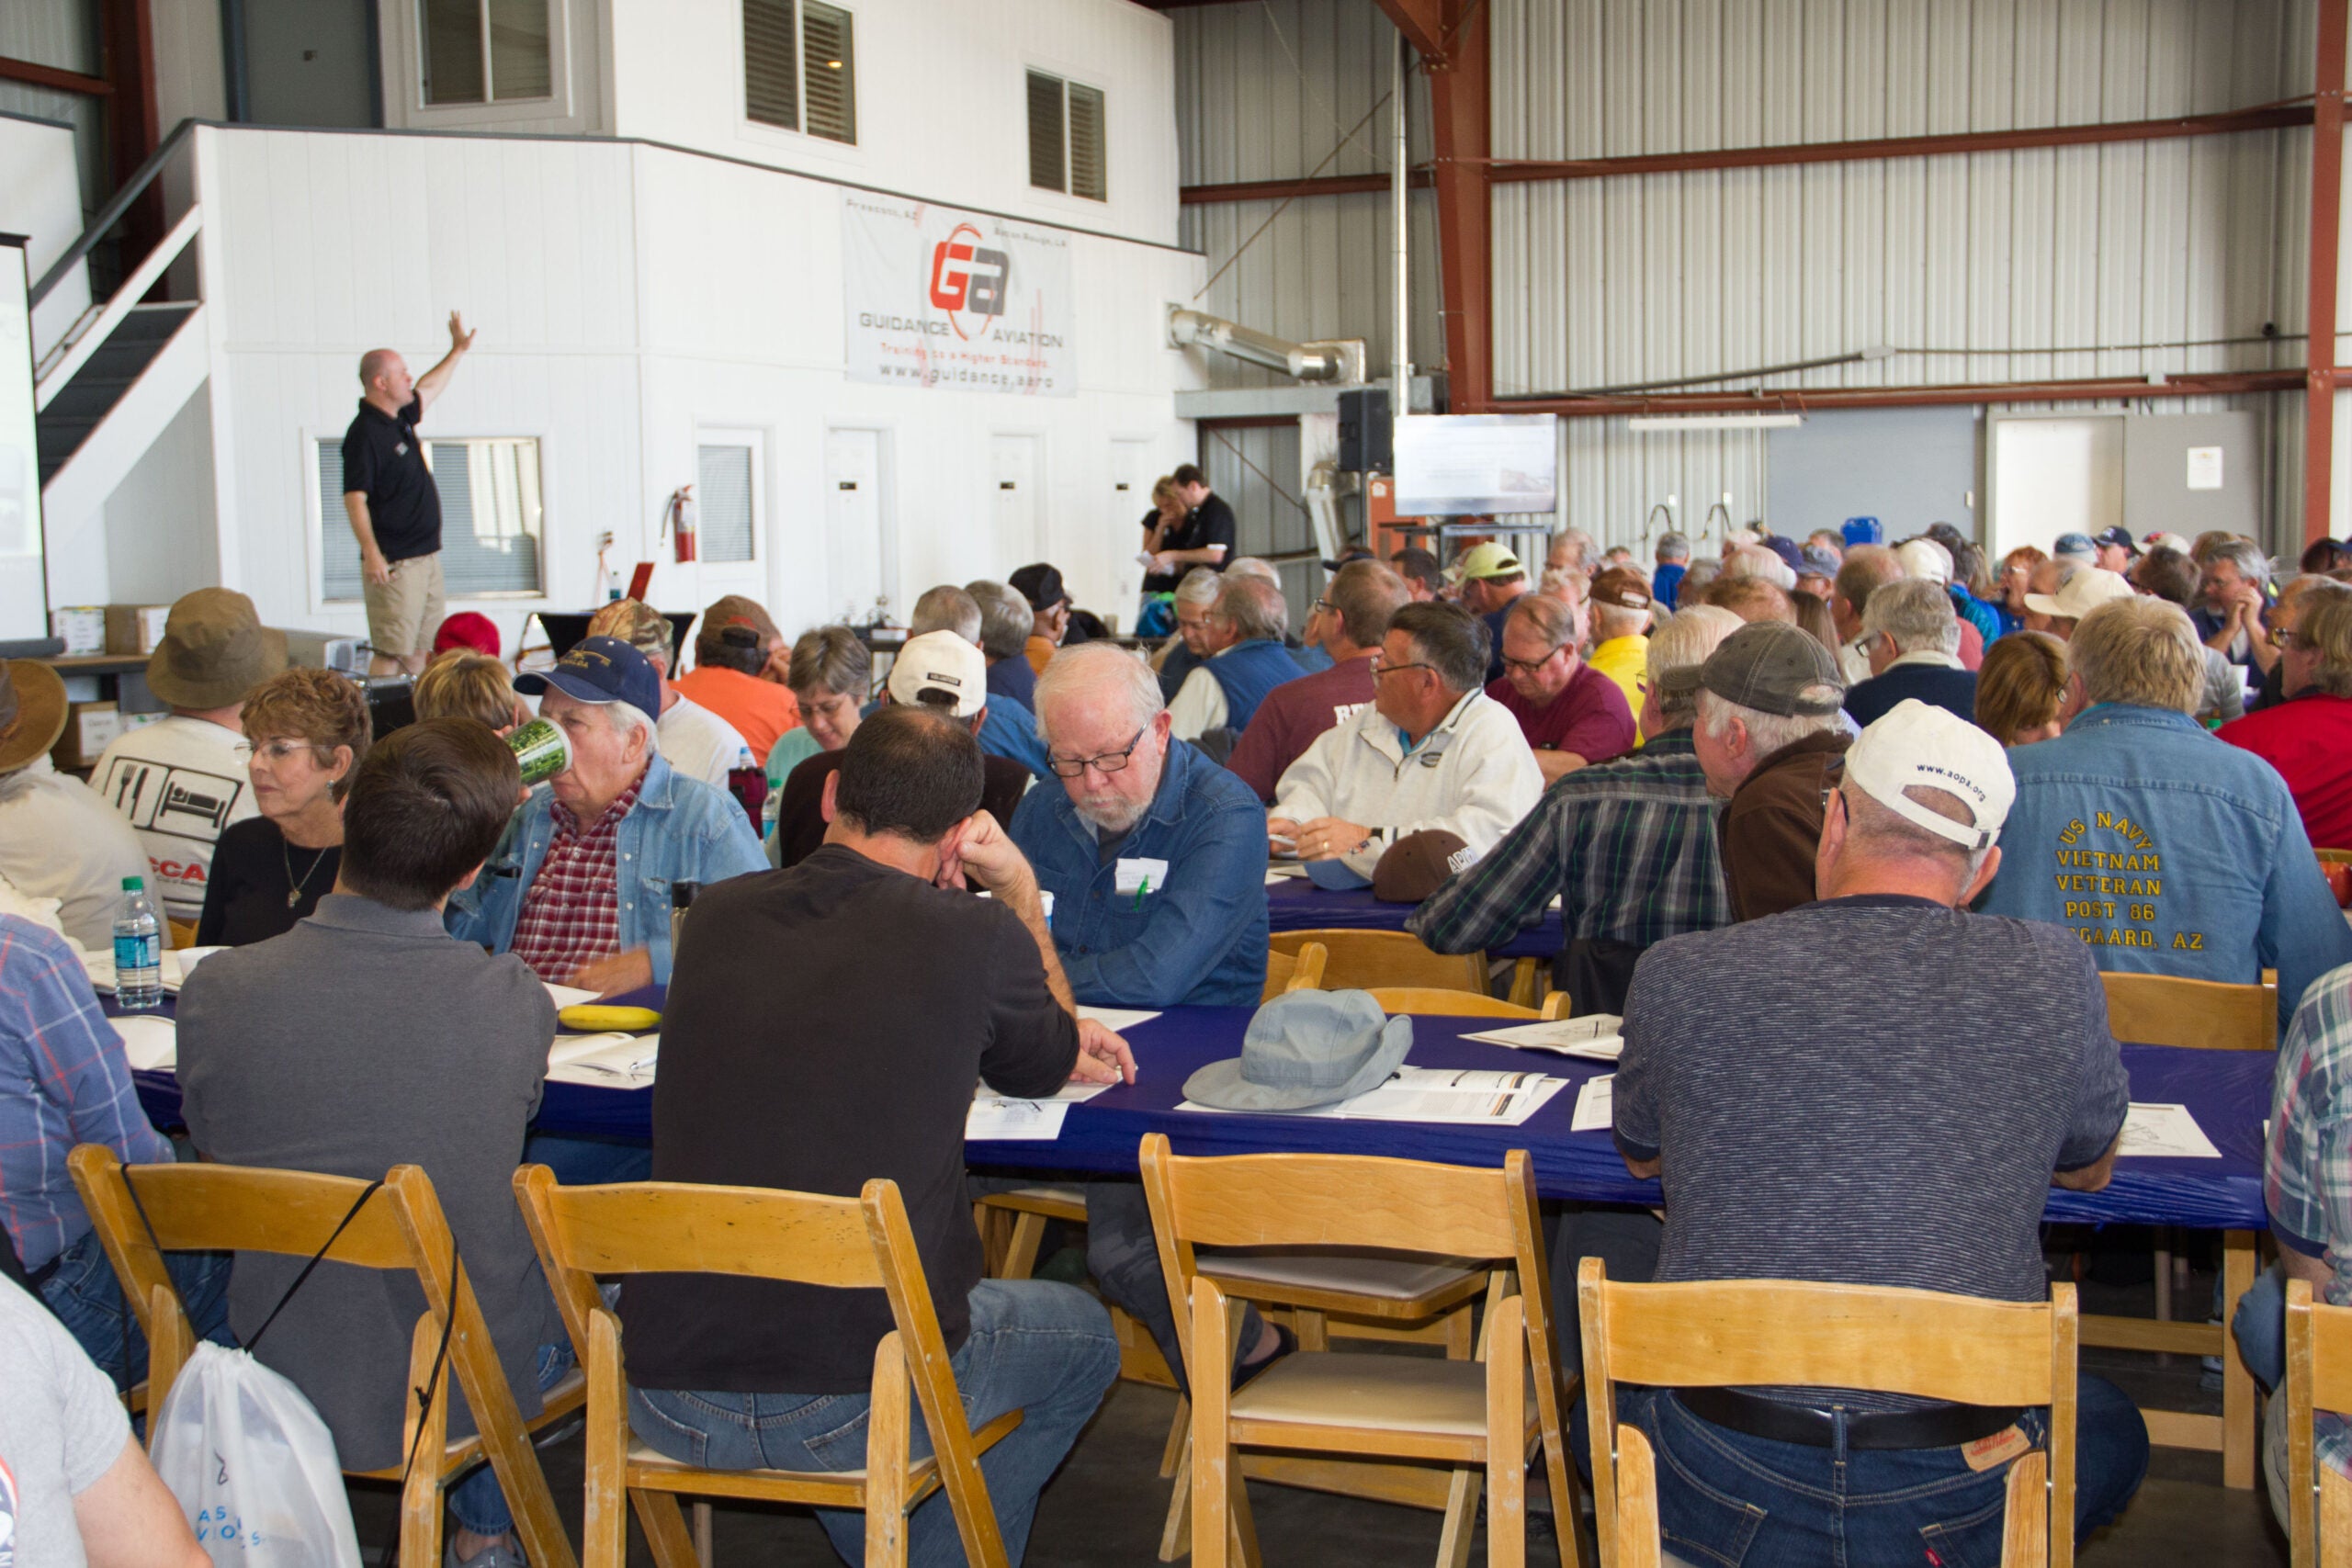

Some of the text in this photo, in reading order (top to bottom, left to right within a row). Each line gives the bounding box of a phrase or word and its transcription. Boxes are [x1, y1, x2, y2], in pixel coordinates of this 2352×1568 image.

[859, 311, 950, 336] GUIDANCE
[992, 329, 1064, 348] AVIATION
[881, 342, 927, 362] Training
[960, 353, 996, 367] Higher
[878, 365, 1054, 389] www.guidance.aero
[1916, 763, 1986, 803] www.aopa.org
[2059, 811, 2153, 851] US NAVY
[2055, 850, 2160, 872] VIETNAM
[2055, 874, 2161, 897] VETERAN
[2065, 901, 2155, 921] POST 86
[2172, 932, 2203, 950] AZ
